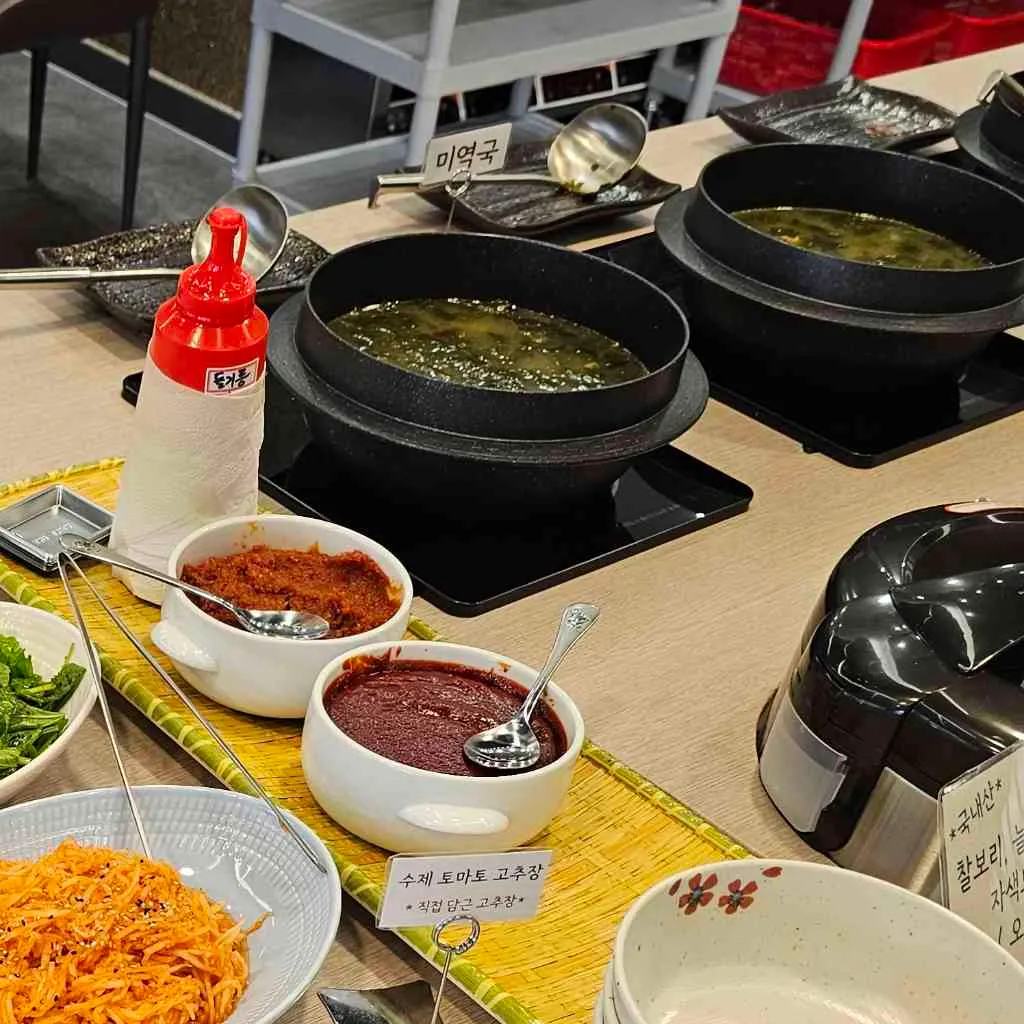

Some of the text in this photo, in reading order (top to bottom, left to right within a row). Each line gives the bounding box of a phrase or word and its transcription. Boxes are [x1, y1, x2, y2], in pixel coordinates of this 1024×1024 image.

[437, 139, 499, 171] 미역국
[399, 863, 545, 889] 수제 토마토 고추장
[990, 868, 1024, 913] 자색
